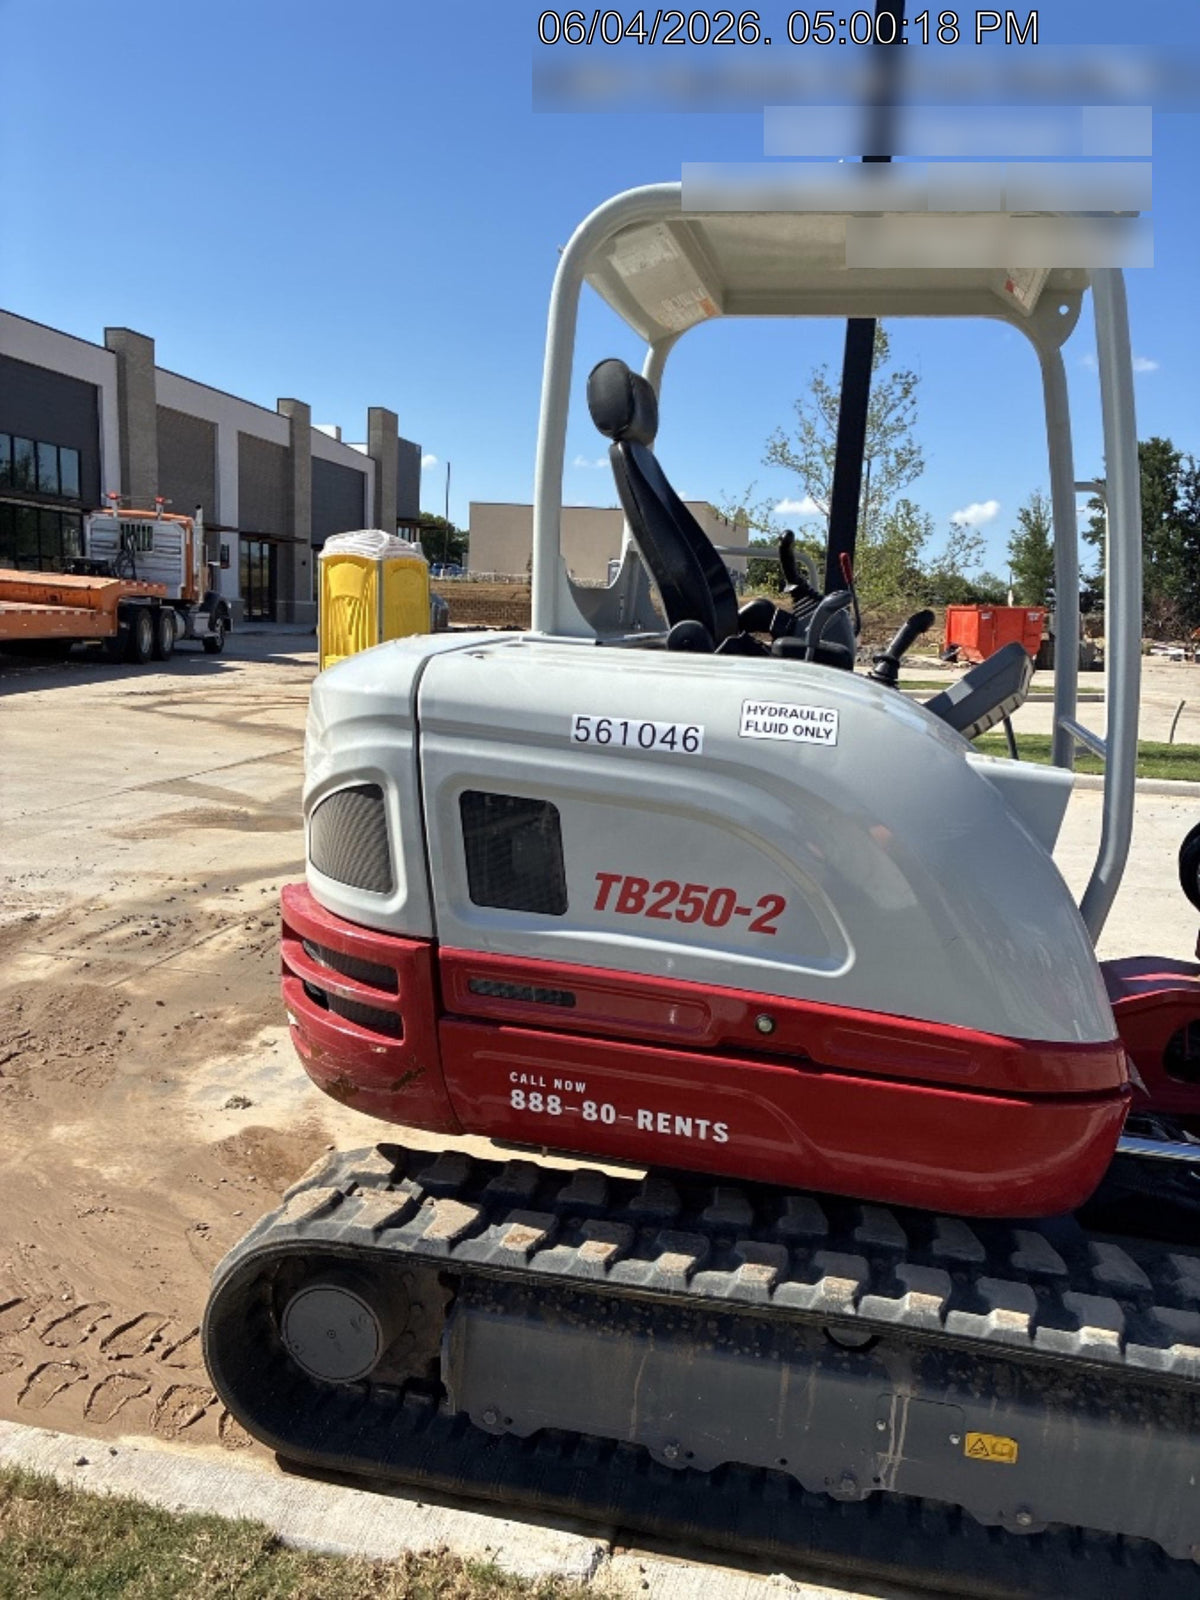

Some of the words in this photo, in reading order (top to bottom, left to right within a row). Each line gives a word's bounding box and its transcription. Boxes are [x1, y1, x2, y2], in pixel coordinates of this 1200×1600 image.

[746, 704, 836, 723] HYDRAULIC
[573, 716, 701, 753] 561046
[744, 720, 790, 735] FLUID
[793, 724, 834, 741] ONLY
[593, 872, 787, 936] TB250-2
[509, 1071, 547, 1088] CALL
[554, 1078, 587, 1094] NOW
[510, 1088, 730, 1143] 888-80-RENTS
